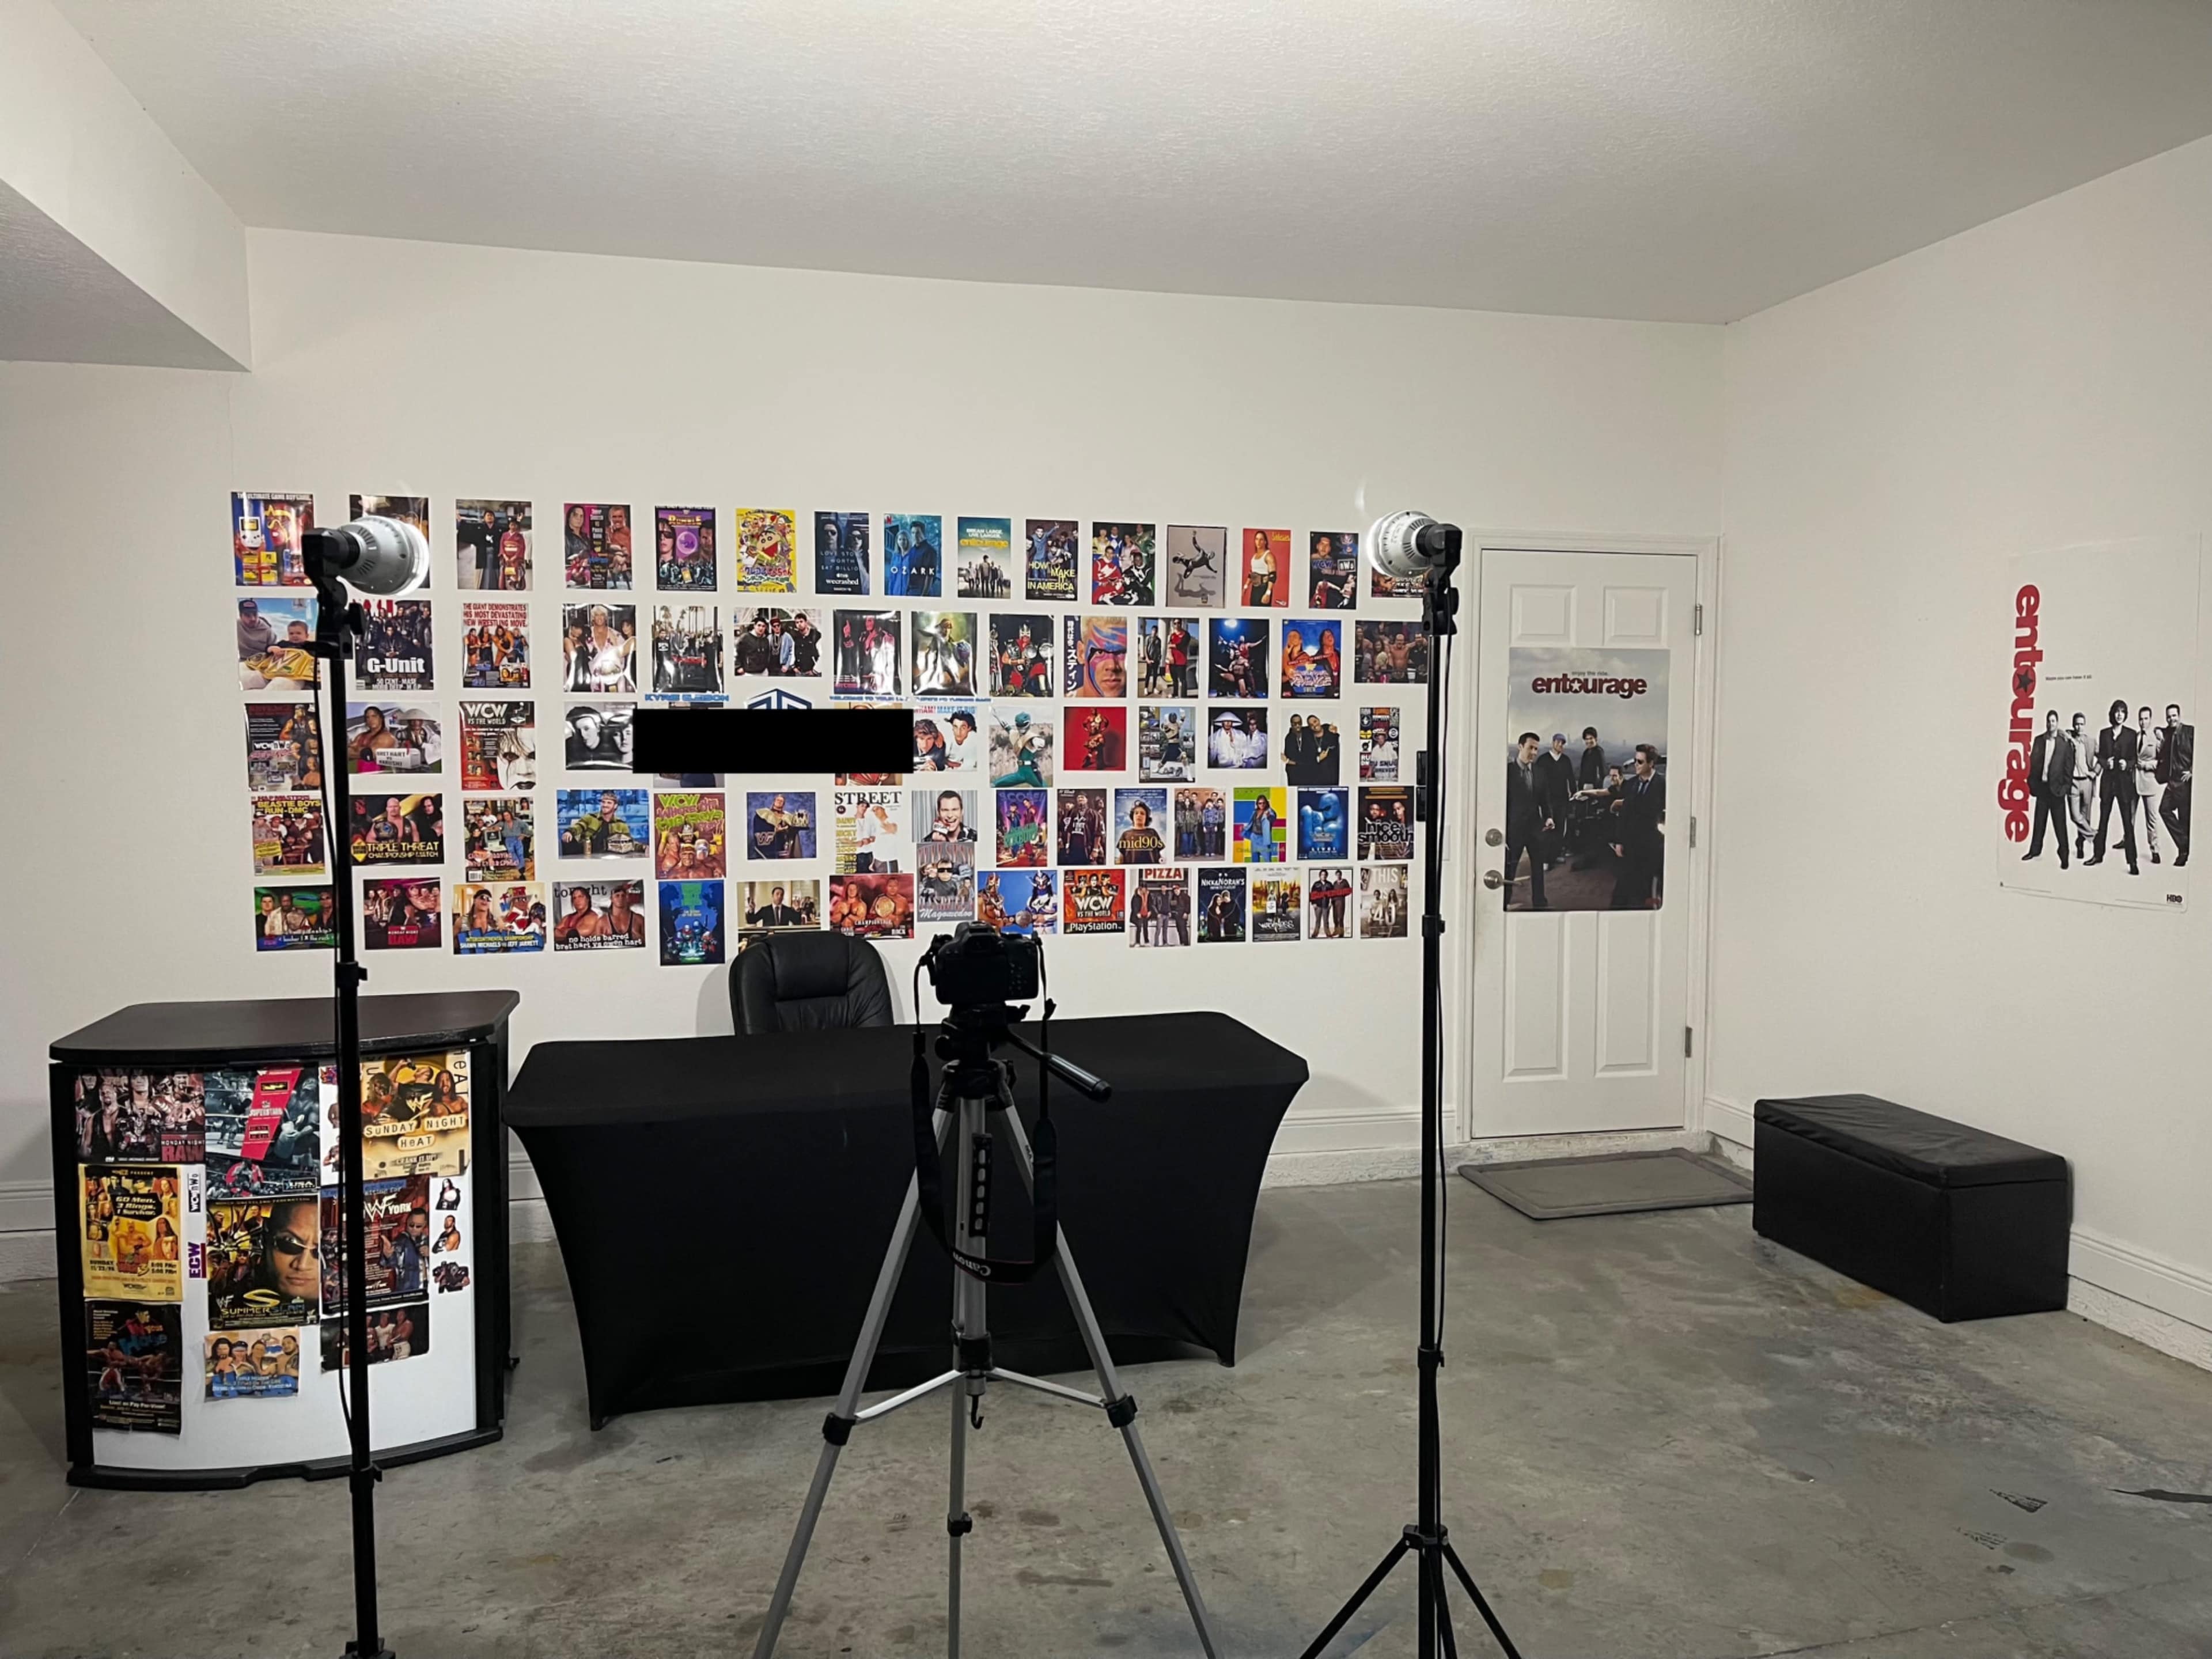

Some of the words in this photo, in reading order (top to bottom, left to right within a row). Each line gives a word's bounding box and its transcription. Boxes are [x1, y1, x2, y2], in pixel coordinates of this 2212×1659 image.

[891, 566, 935, 575] OZARK
[1051, 569, 1075, 578] MAKE
[1028, 581, 1036, 589] IN
[1036, 581, 1074, 590] AMERICA
[367, 658, 425, 673] G-Unit
[1532, 673, 1647, 699] entourage
[464, 703, 508, 718] WCW
[1997, 584, 2044, 843] entourage
[658, 794, 701, 808] WCW
[835, 791, 902, 805] STREET
[366, 842, 399, 852] TRIPLE
[401, 841, 440, 852] THREAT
[1119, 837, 1163, 849] mid90s
[1145, 868, 1183, 880] PIZZA
[1372, 868, 1398, 883] THIS
[554, 885, 607, 898] tonht
[1075, 896, 1113, 911] WCW
[2166, 893, 2183, 904] HBO
[1070, 922, 1118, 933] PlayStation
[573, 941, 590, 949] hart
[624, 938, 642, 946] hart
[162, 1145, 204, 1162] RAW
[124, 1203, 156, 1211] Rings.
[388, 1202, 412, 1215] YORK
[188, 1242, 200, 1279] ECW
[952, 1251, 991, 1277] Canon
